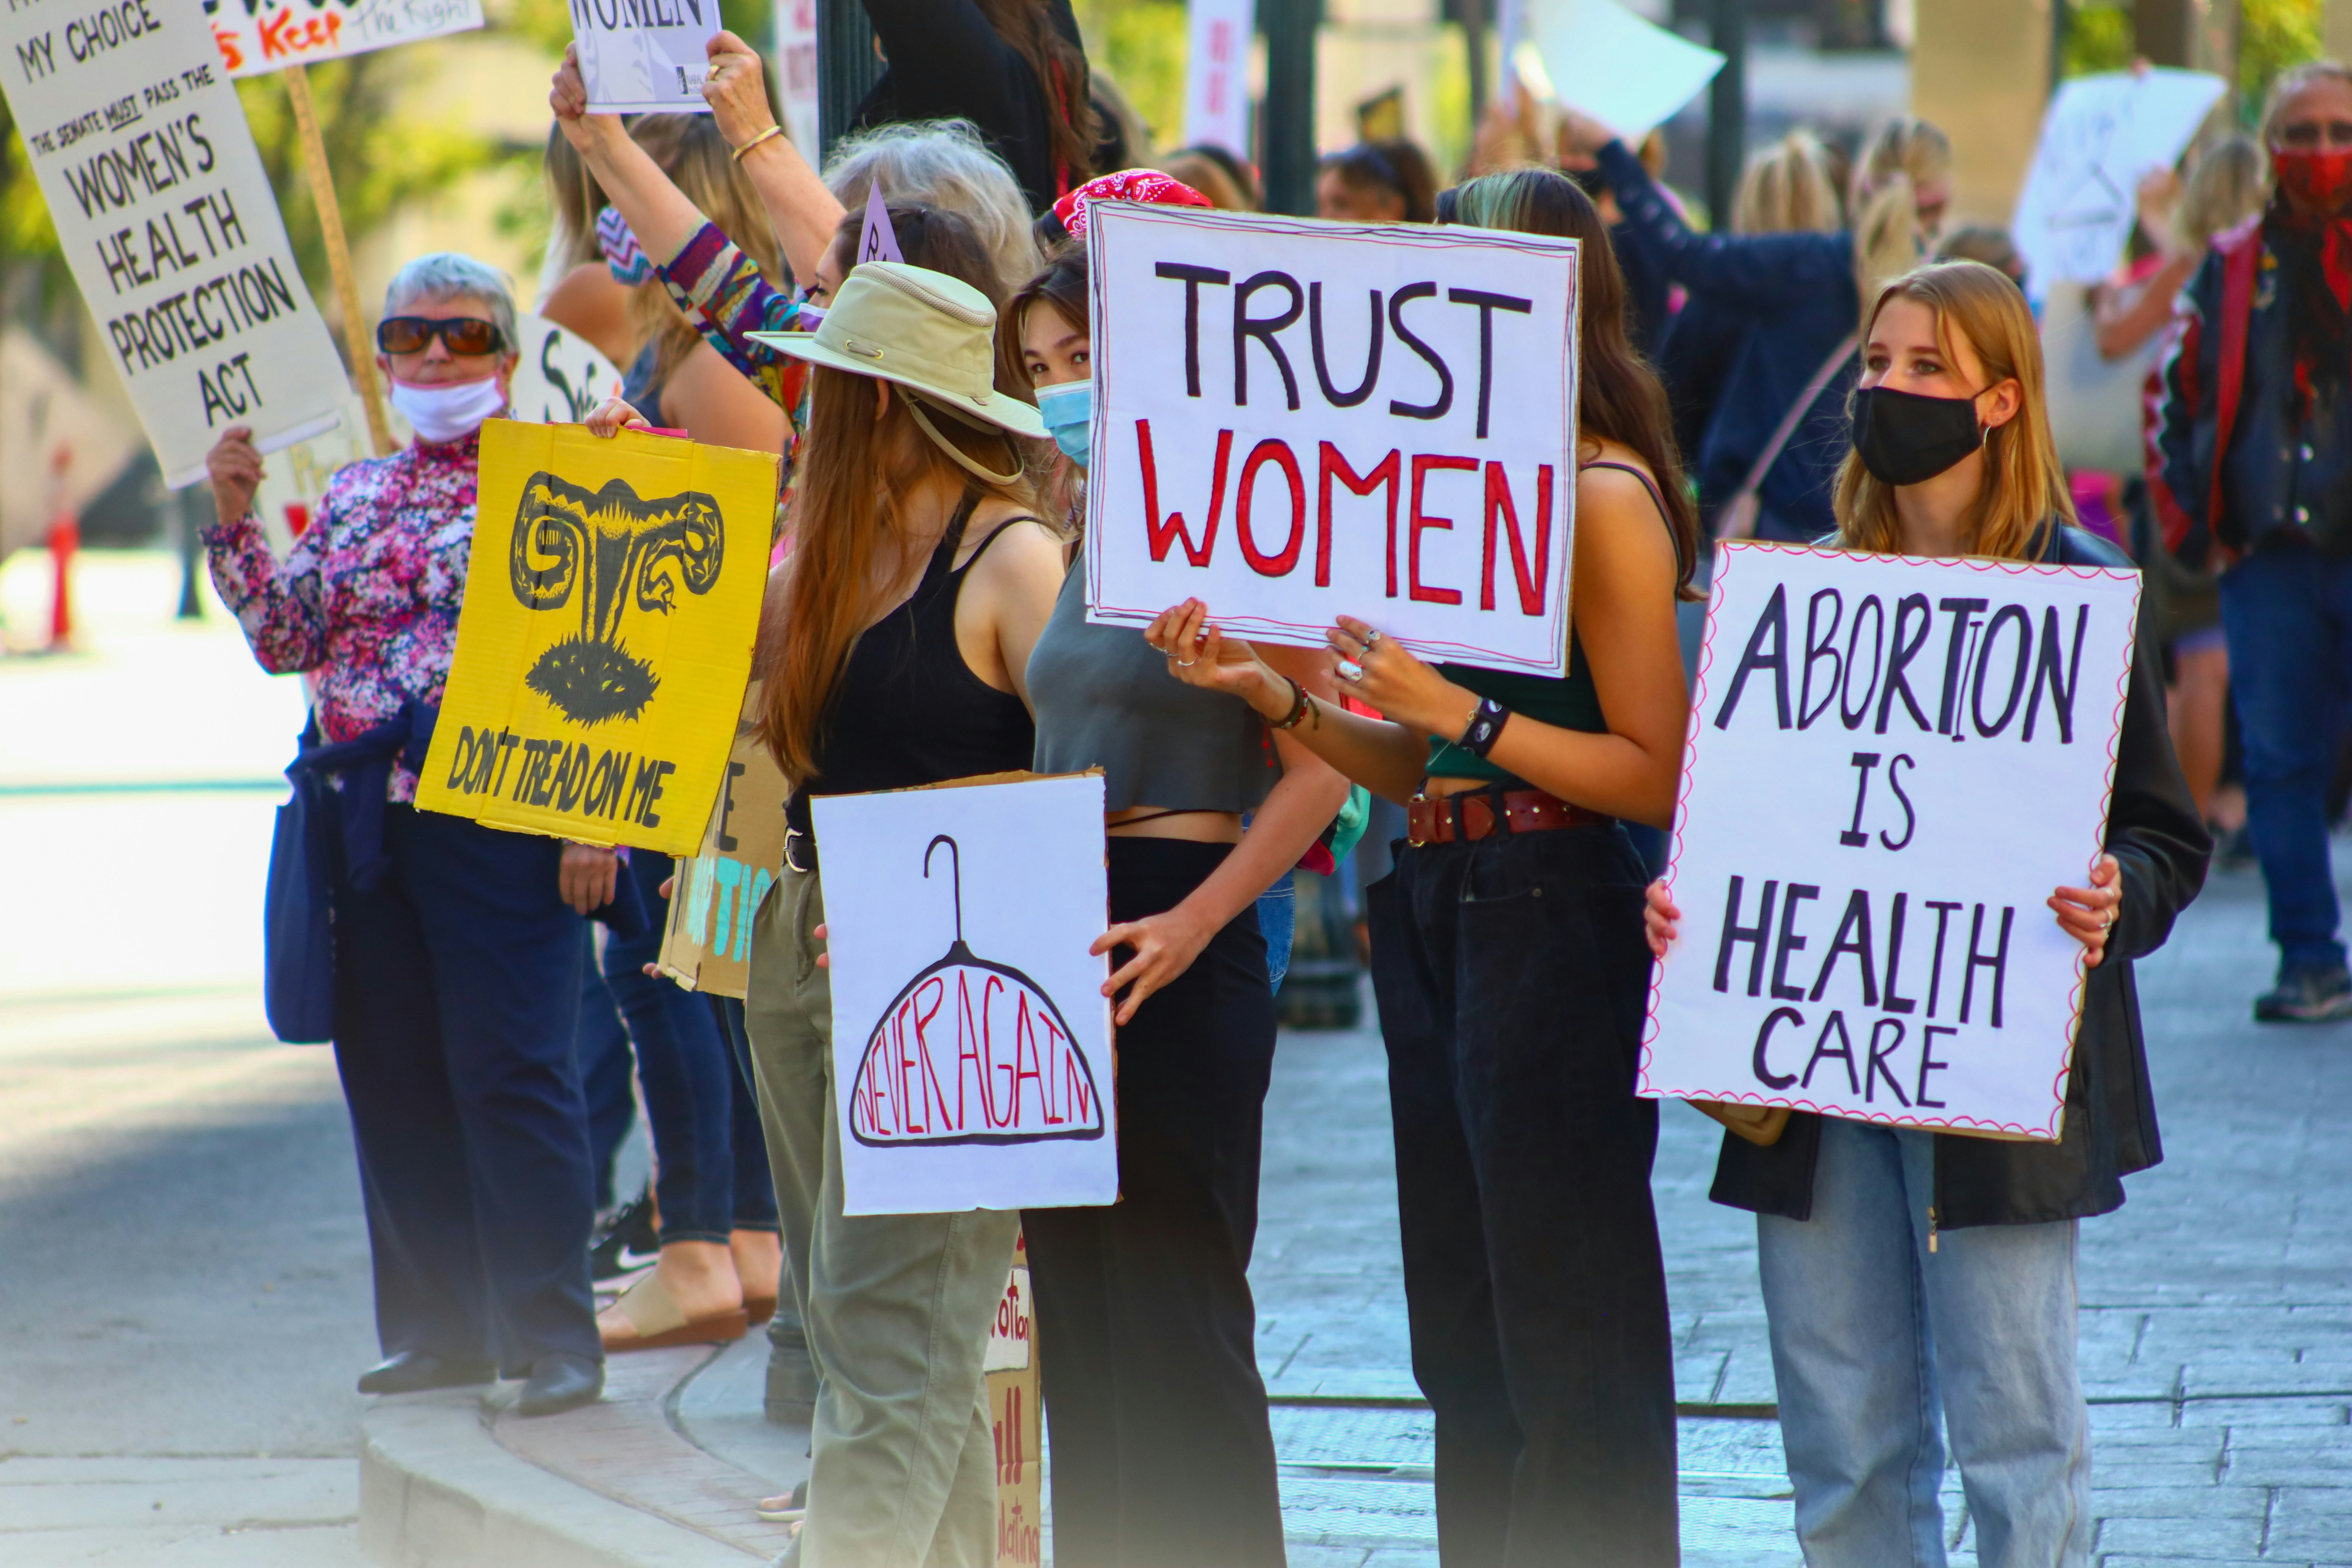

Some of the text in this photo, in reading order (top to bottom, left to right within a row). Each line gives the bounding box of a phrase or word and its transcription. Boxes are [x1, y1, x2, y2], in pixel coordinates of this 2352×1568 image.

[16, 0, 162, 84] MY CHOICE
[31, 63, 215, 156] THE SENATE MUST PASS THE
[64, 113, 215, 219] WOMEN'S
[97, 188, 247, 295] HEALTH
[108, 257, 297, 376] PROTECTION
[1155, 262, 1533, 439] TRUST
[198, 352, 262, 428] ACT
[1135, 419, 1554, 616] WOMEN
[1713, 582, 2090, 744] ABORTION
[446, 726, 676, 828] DON'T TREAD ON ME
[1839, 752, 1917, 852] IS
[1713, 874, 2015, 1029] HEALTH
[858, 969, 1089, 1135] NEVER AGAIN
[1752, 1007, 1959, 1109] CARE
